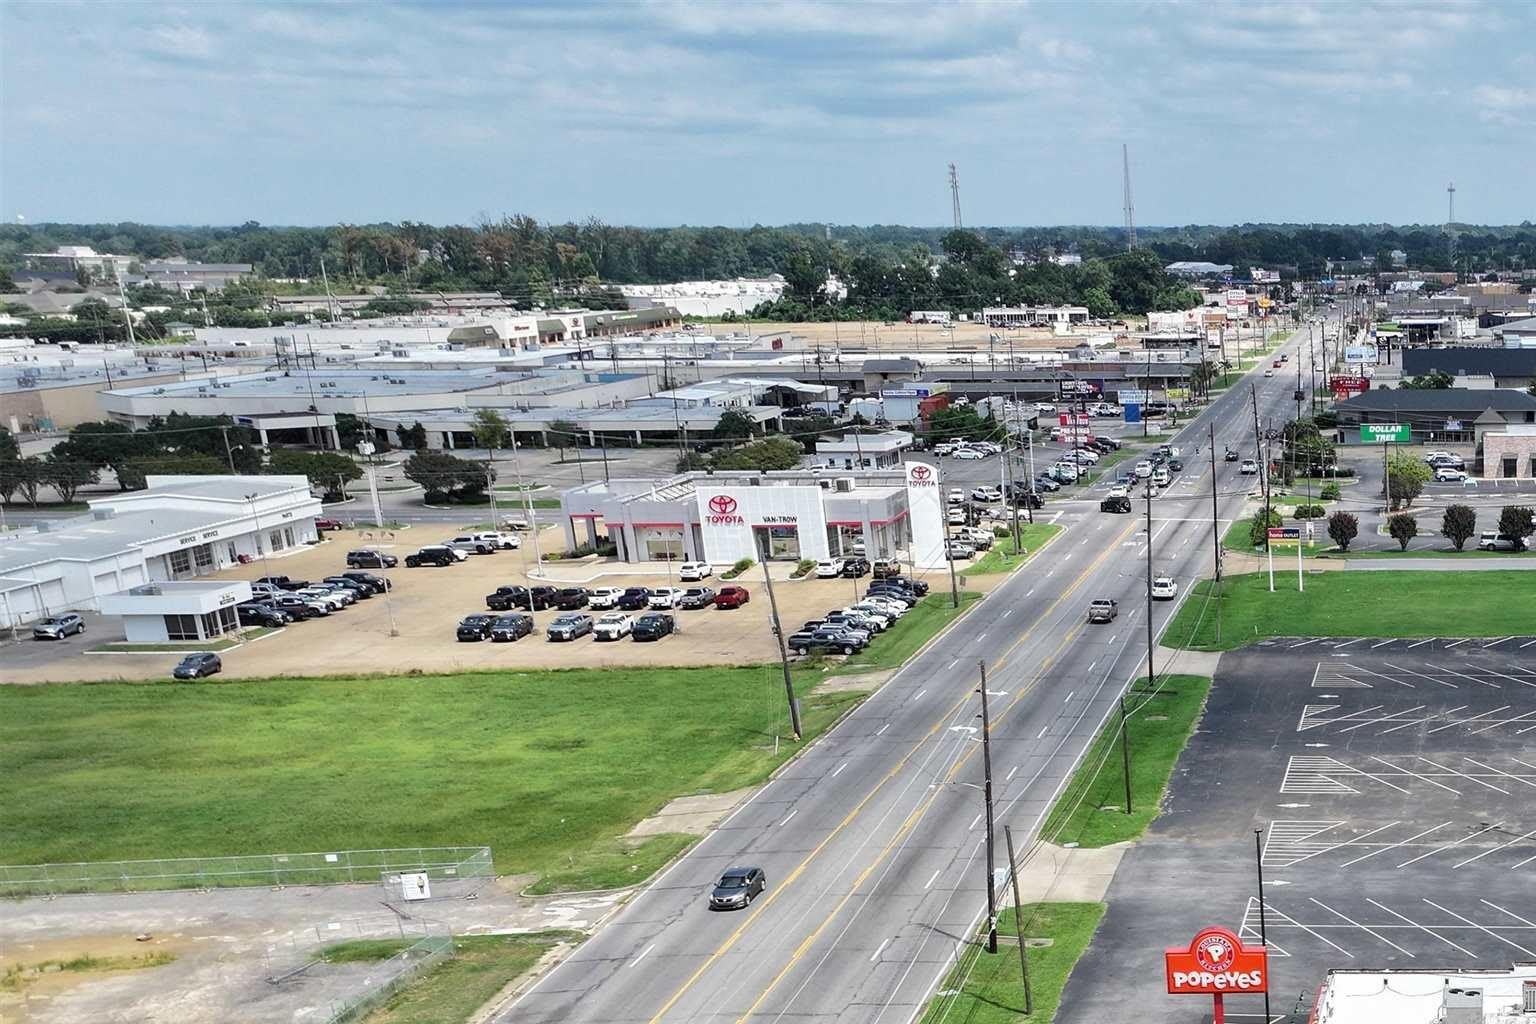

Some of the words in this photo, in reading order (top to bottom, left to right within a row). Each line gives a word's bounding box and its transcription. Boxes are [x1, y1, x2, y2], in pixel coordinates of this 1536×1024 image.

[1369, 425, 1402, 433] DOLLAR
[1375, 433, 1396, 441] TREE
[705, 515, 744, 524] TOYOTA
